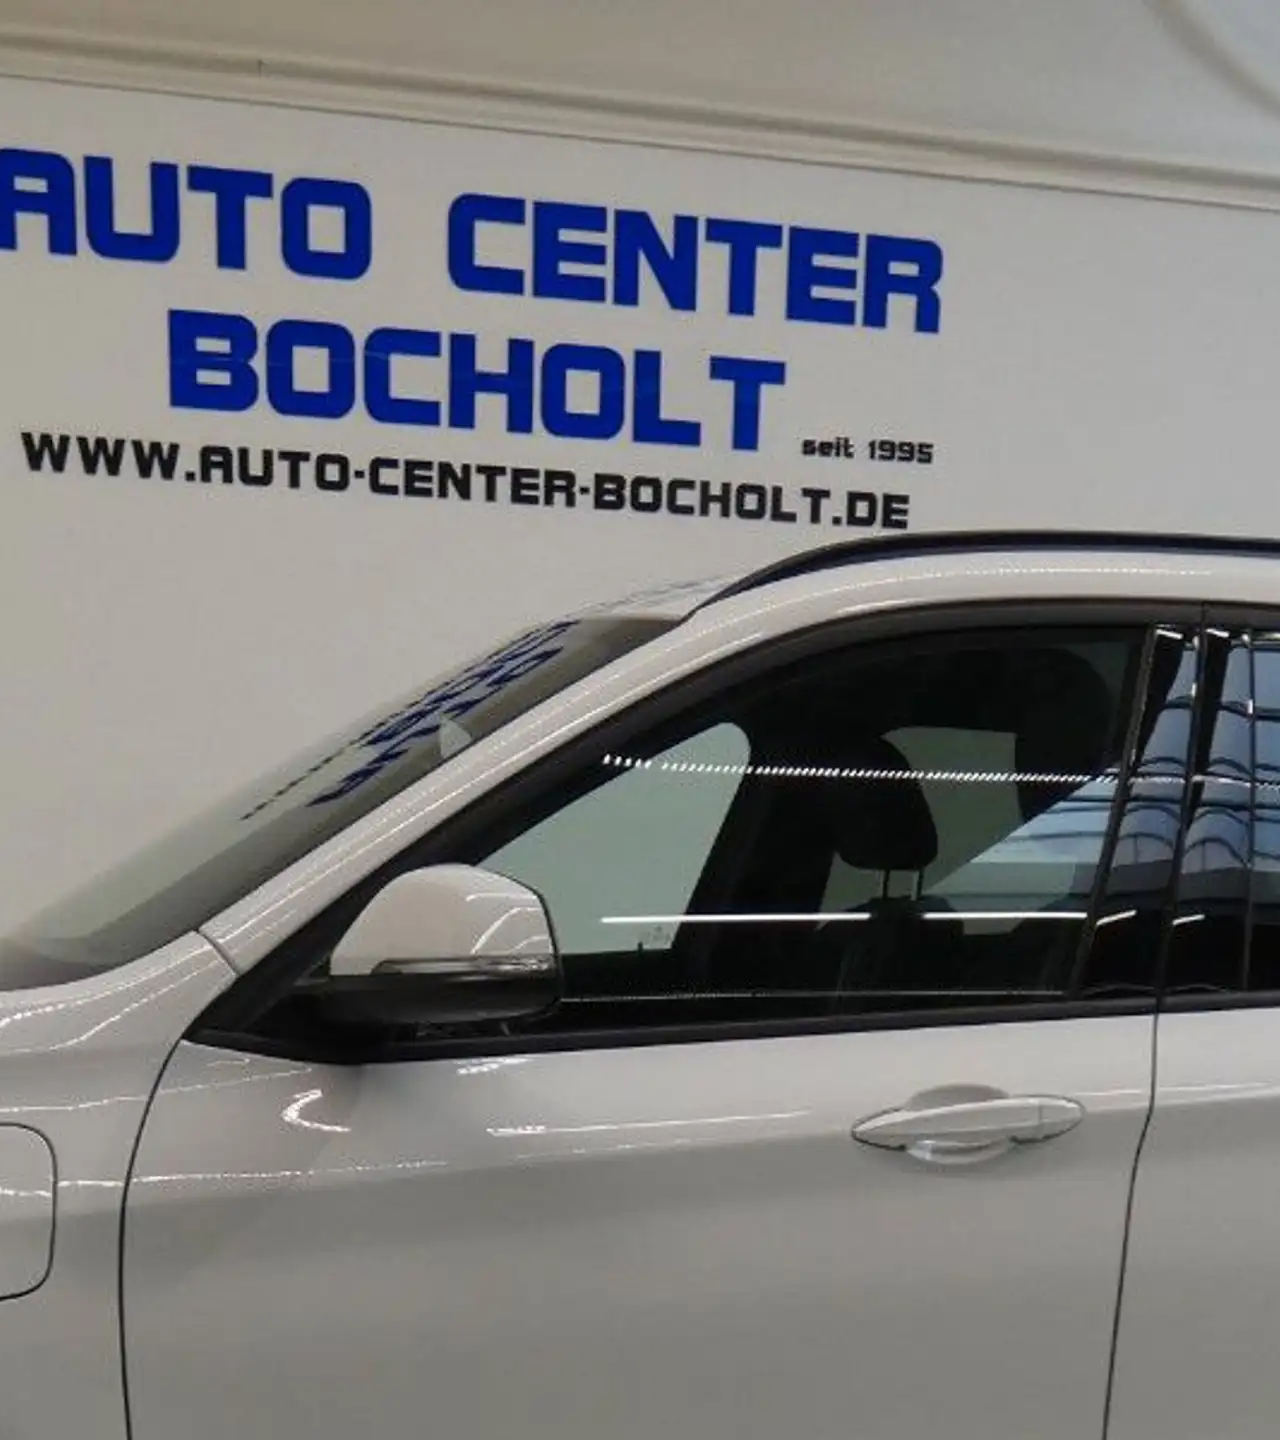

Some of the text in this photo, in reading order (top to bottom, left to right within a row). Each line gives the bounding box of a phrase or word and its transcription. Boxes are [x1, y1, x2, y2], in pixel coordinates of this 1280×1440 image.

[446, 192, 945, 335] CENTER
[166, 308, 787, 452] BOCHOLT
[19, 430, 911, 531] WWW.AUTO-CENTER-BOCHOLT.DE
[802, 436, 934, 464] seit 1995
